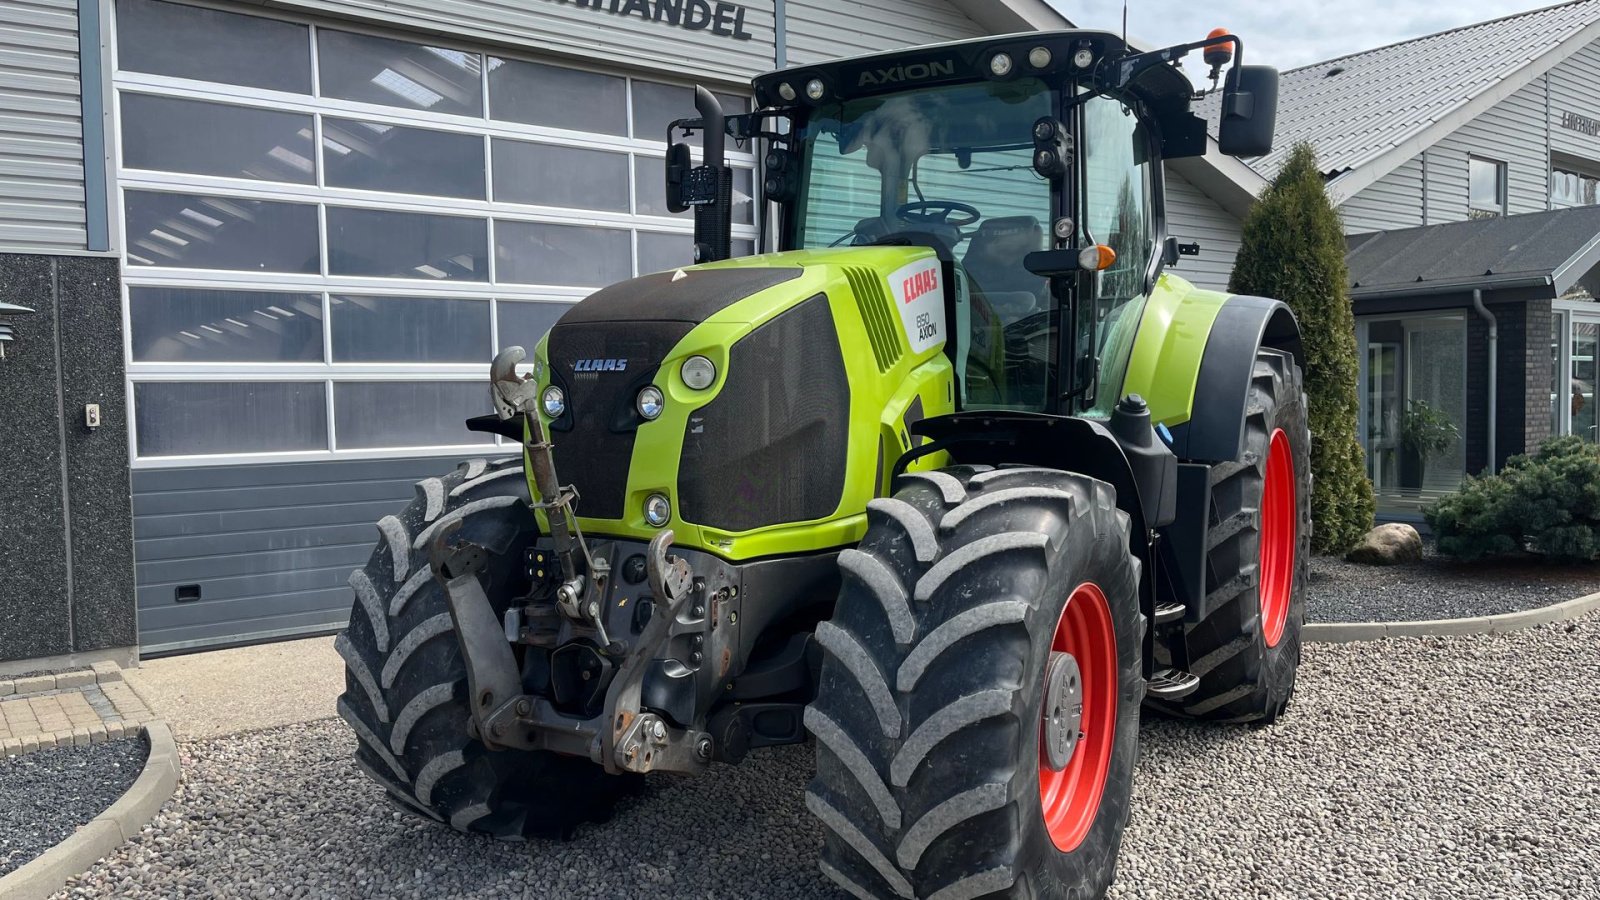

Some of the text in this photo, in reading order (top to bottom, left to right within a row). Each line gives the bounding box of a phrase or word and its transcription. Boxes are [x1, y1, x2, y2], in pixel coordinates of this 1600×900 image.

[560, 0, 752, 40] ANDEL
[903, 268, 938, 304] CLAAS
[916, 312, 930, 328] 850
[919, 322, 937, 342] AXION
[574, 359, 628, 371] CLAAS
